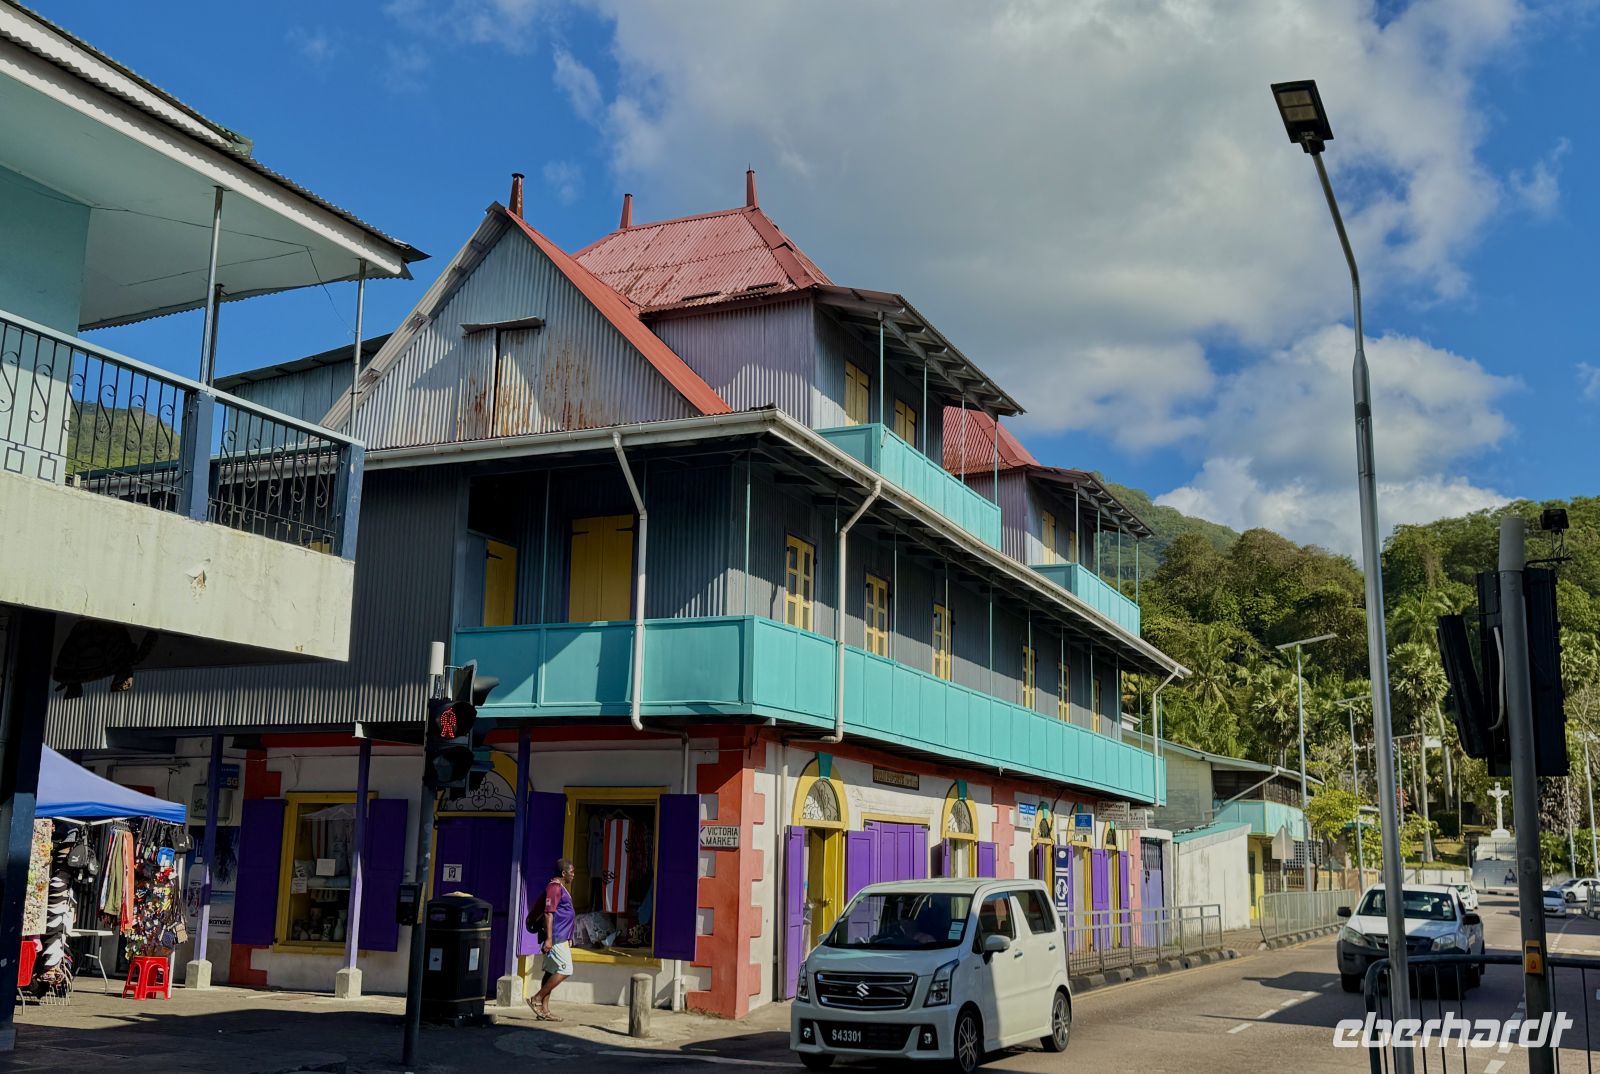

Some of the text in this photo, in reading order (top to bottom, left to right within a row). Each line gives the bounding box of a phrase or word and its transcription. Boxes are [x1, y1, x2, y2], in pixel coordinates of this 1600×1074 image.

[707, 827, 738, 836] VICTORIA
[706, 836, 737, 846] MARKET
[832, 1029, 862, 1043] S43301
